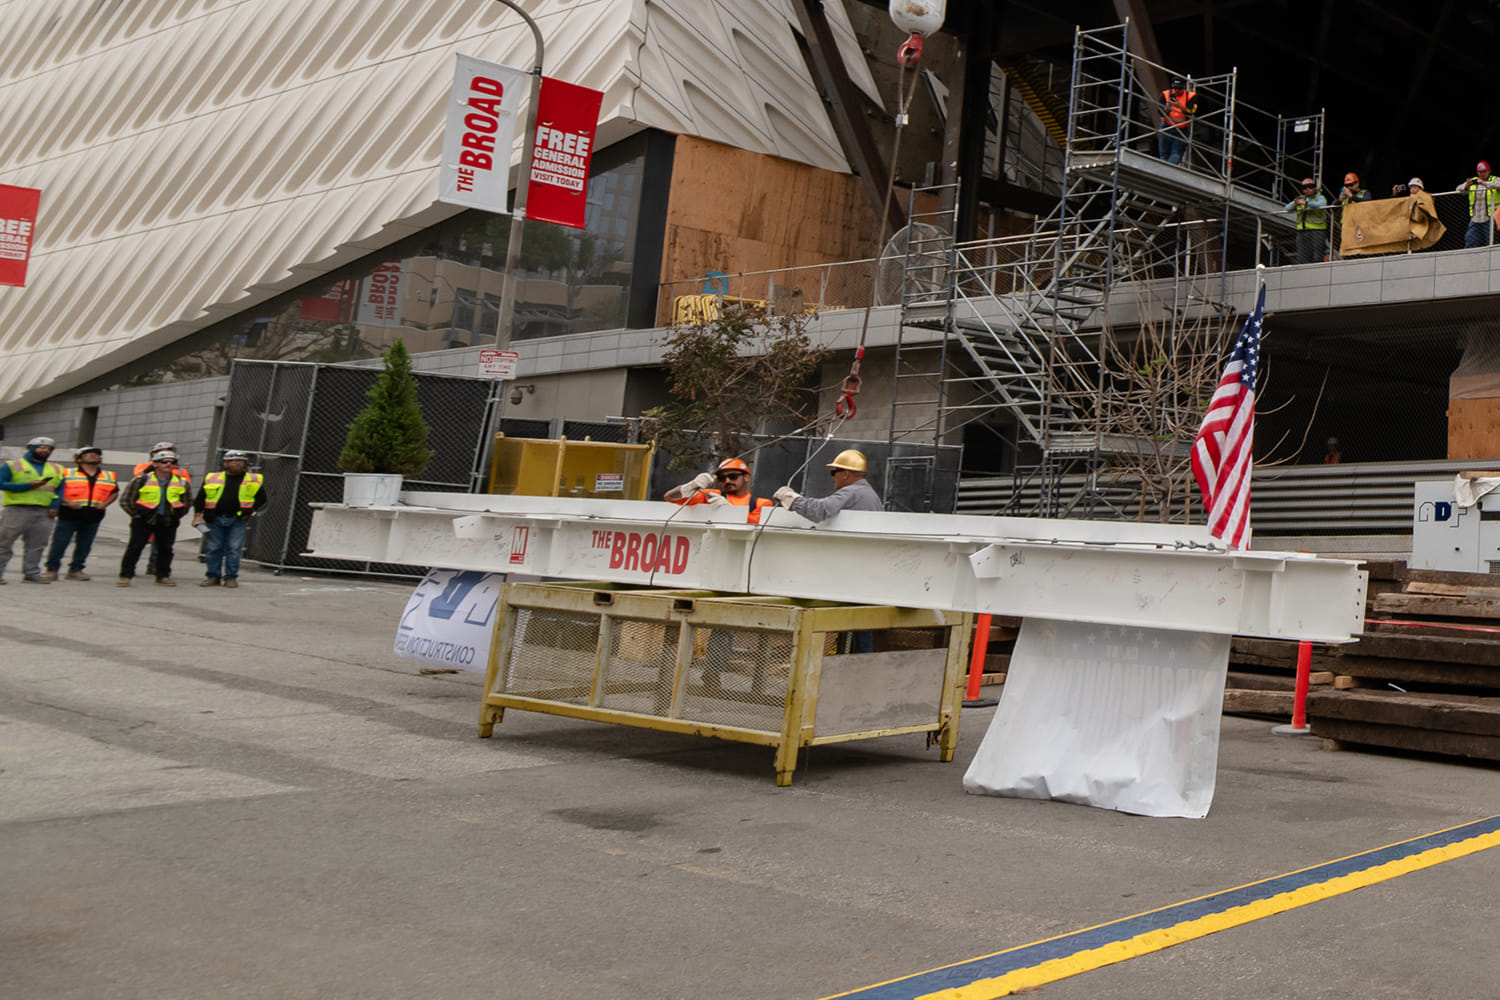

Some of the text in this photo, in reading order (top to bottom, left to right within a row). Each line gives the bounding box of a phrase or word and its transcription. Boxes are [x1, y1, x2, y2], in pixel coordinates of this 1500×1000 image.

[457, 76, 504, 192] THE BROAD
[535, 125, 591, 157] FREE
[532, 159, 585, 179] ADMISSION
[533, 147, 586, 168] GENERAL
[533, 171, 581, 188] VISIT TODAY
[1418, 501, 1468, 528] ADF
[592, 530, 690, 575] THE BROAD
